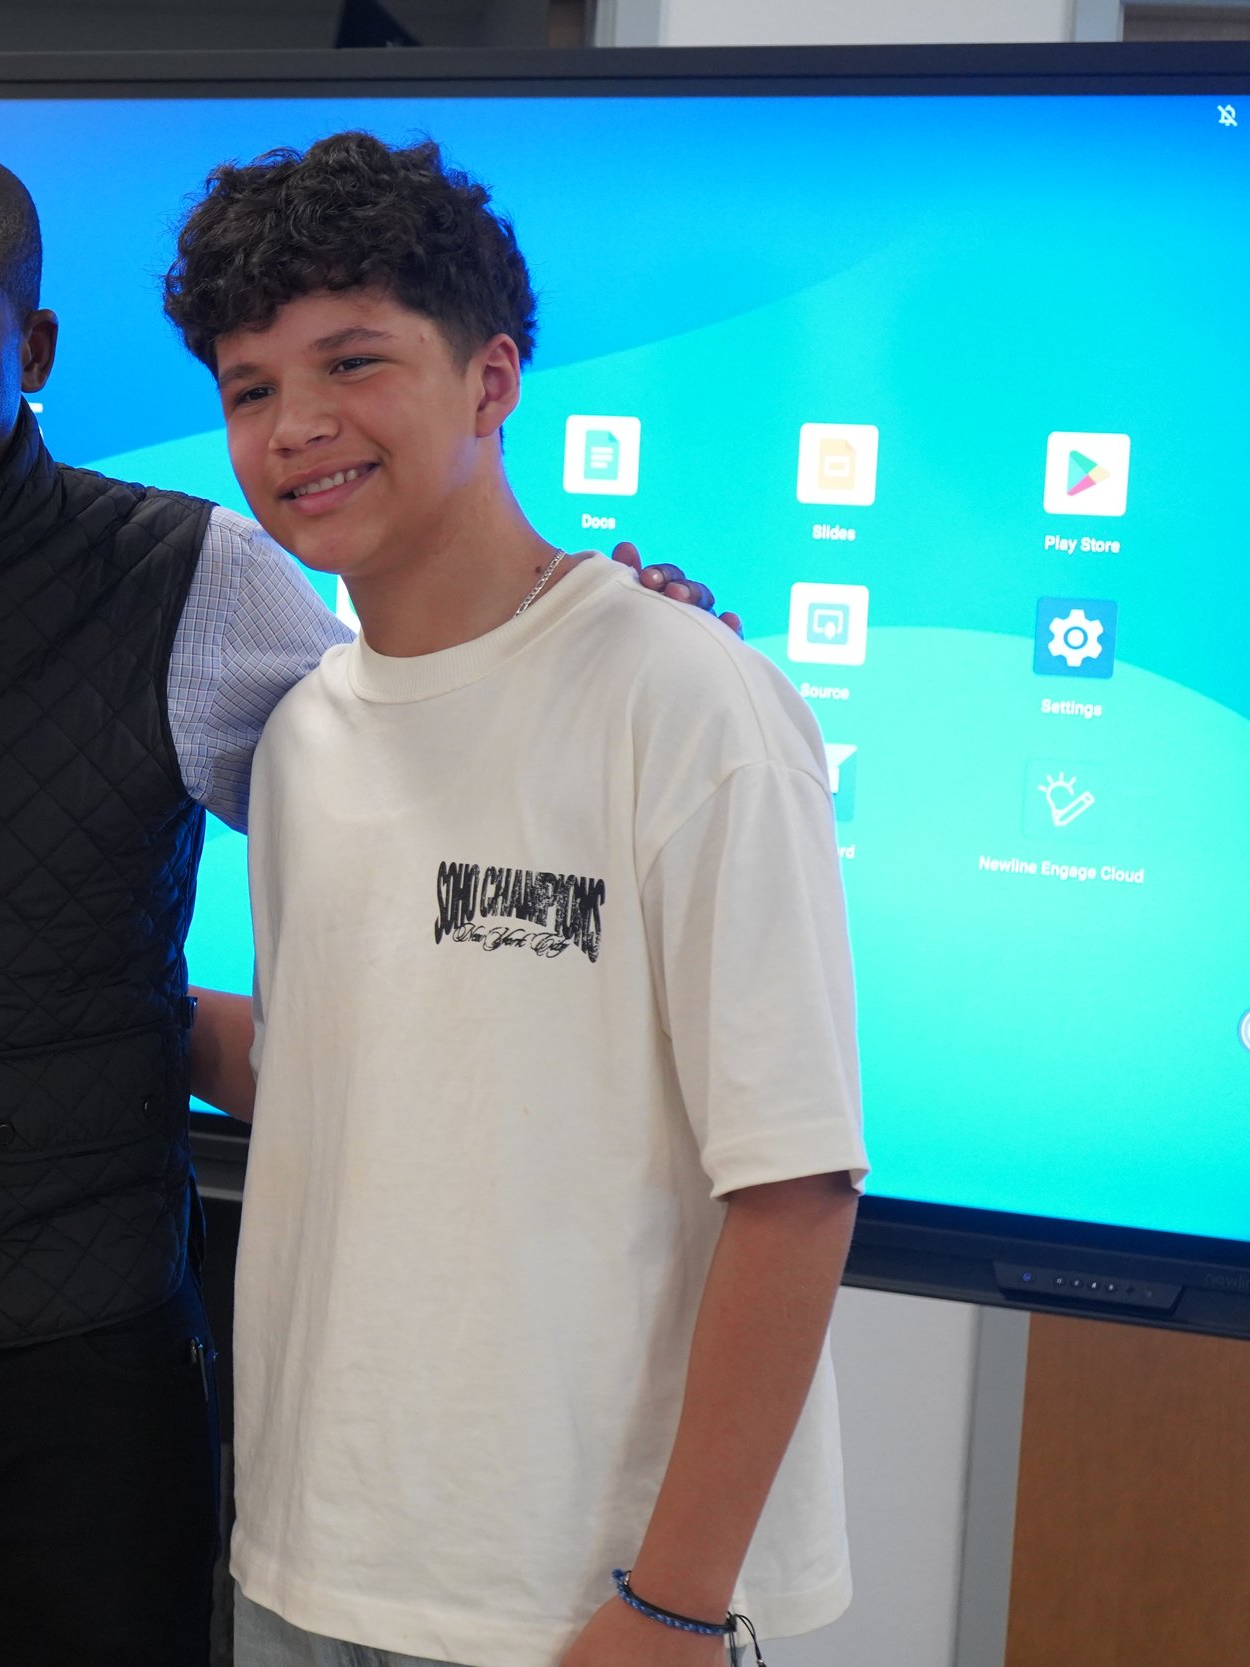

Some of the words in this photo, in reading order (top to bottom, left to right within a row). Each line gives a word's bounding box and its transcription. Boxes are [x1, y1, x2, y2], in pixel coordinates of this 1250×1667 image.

[581, 513, 616, 530] Docs
[812, 523, 856, 541] Slides
[1044, 534, 1078, 555] Play
[1080, 536, 1121, 554] Store
[800, 682, 850, 700] Source
[1041, 698, 1103, 719] Settings
[978, 855, 1037, 874] Newline
[1041, 860, 1096, 881] Engage
[1100, 866, 1145, 883] Cloud
[434, 861, 480, 944] SOHO
[480, 866, 606, 963] CHAMPIONS
[453, 923, 486, 942] New
[483, 927, 529, 951] York
[530, 932, 570, 958] City
